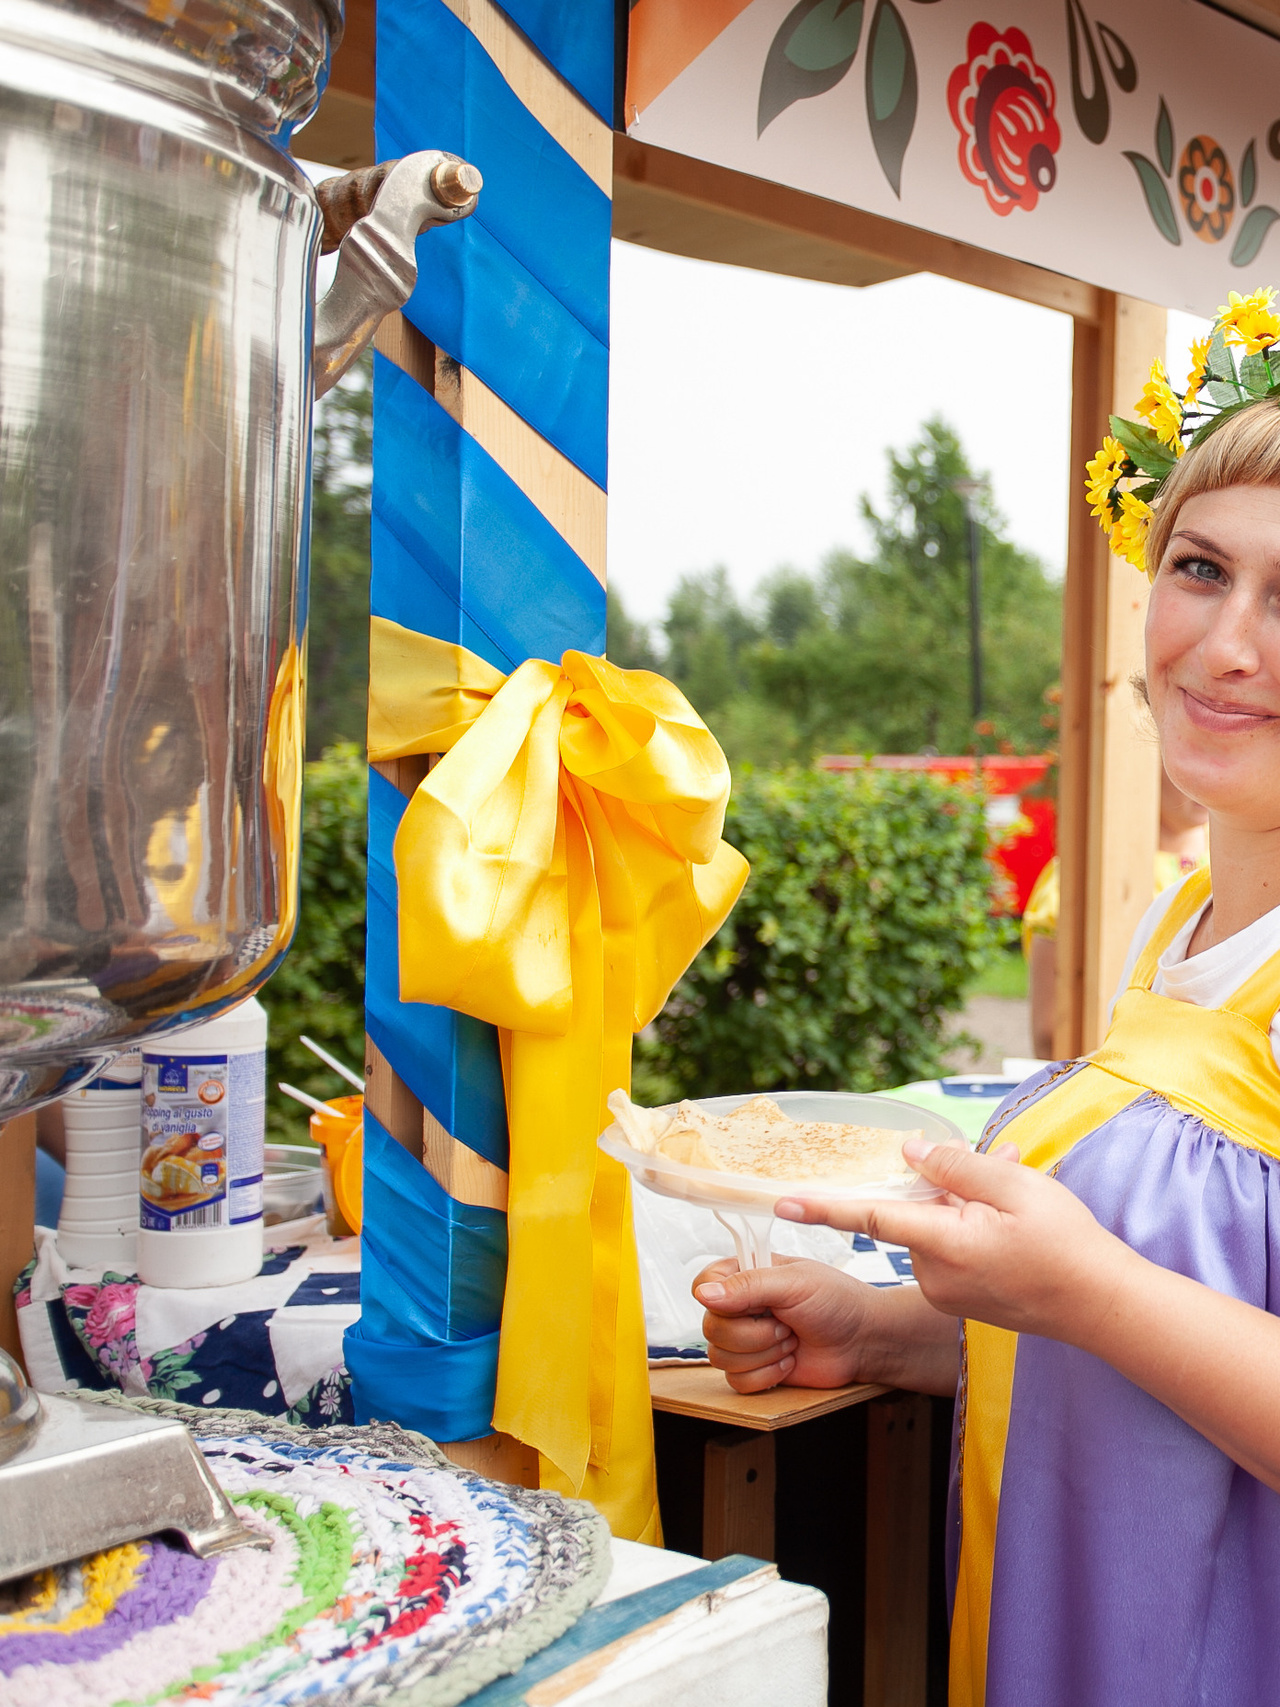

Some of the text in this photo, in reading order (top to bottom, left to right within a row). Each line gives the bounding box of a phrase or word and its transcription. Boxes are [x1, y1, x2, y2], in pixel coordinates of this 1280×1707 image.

[173, 1106, 182, 1118] al
[185, 1108, 213, 1121] gusto
[152, 1122, 197, 1135] di vaniglia
